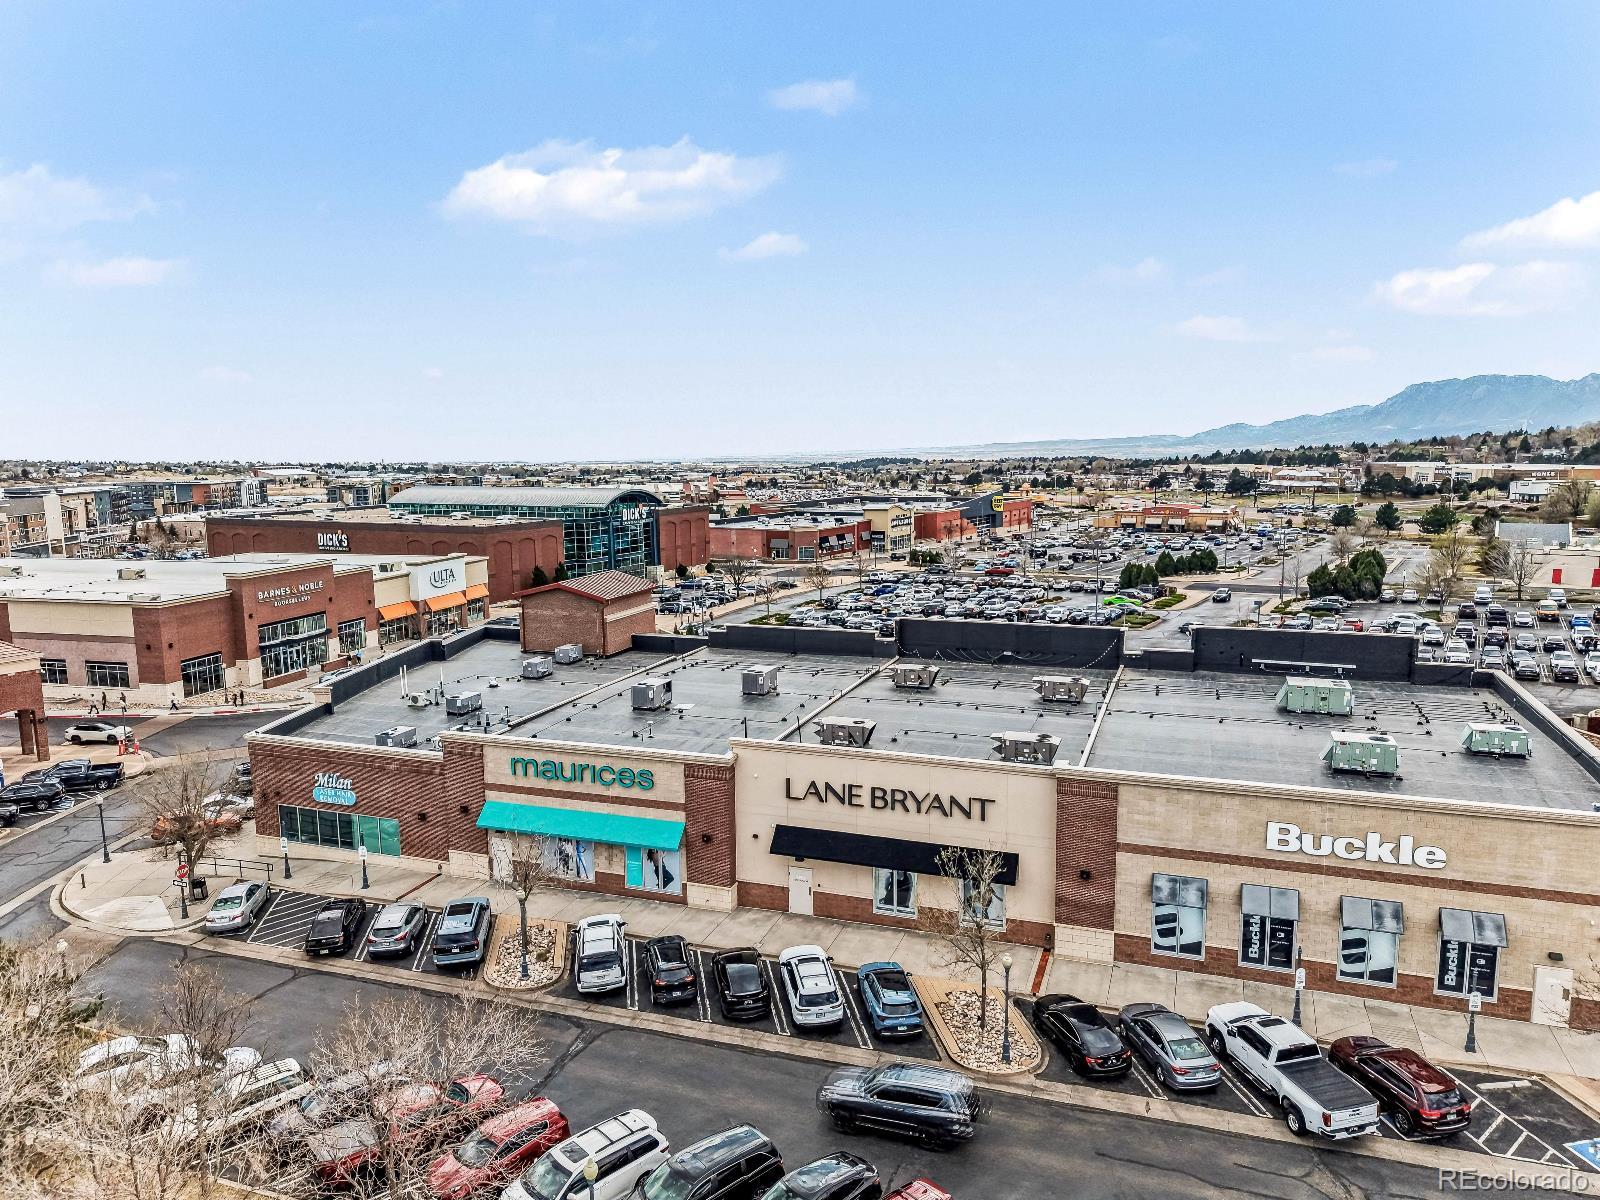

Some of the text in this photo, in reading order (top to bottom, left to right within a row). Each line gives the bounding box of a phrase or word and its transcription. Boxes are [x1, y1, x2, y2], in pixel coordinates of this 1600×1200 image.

[623, 506, 647, 520] DICK'S
[318, 531, 348, 546] DICK'S
[433, 569, 456, 583] ULTA
[258, 587, 291, 600] BARNES
[299, 580, 324, 592] NOBLE
[314, 772, 352, 790] Milan
[510, 756, 655, 790] maurices
[785, 777, 996, 822] LANE BRYANT
[1266, 821, 1447, 869] Buckle
[1248, 915, 1261, 959] Buckl
[1444, 941, 1458, 986] Buckl
